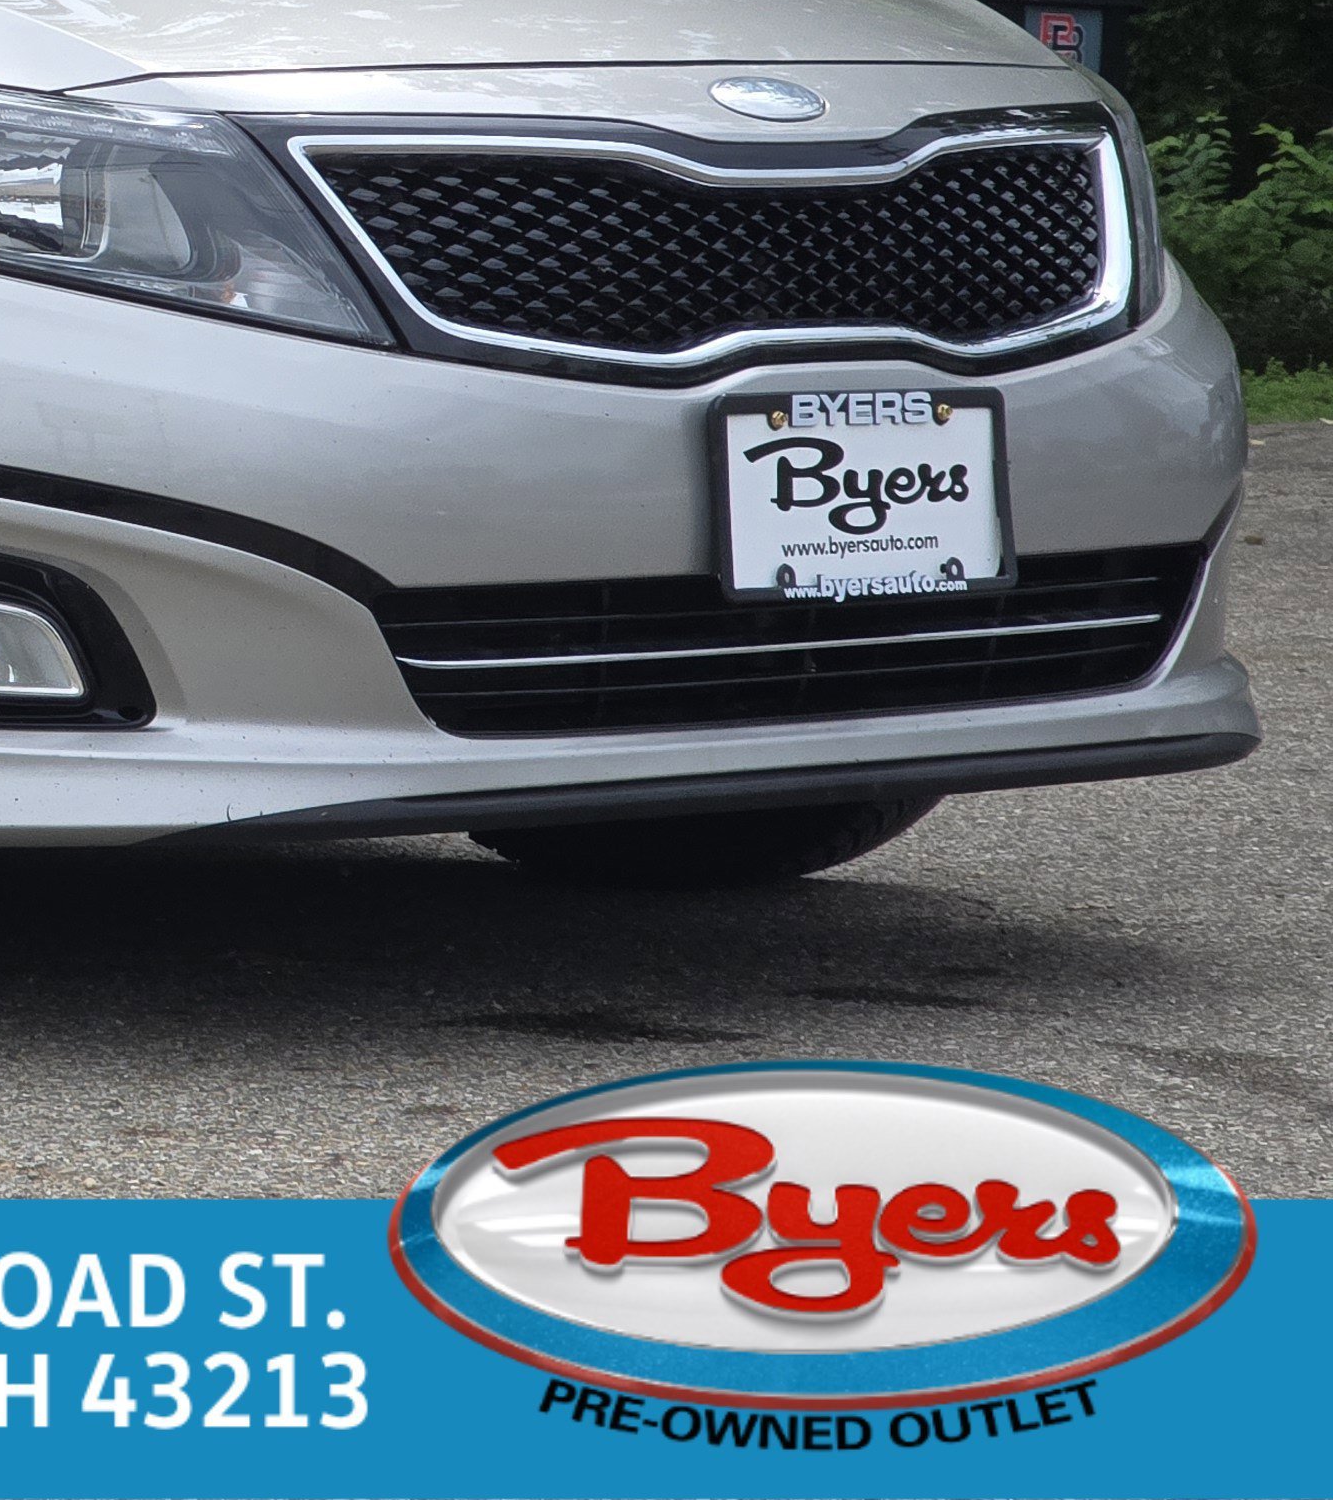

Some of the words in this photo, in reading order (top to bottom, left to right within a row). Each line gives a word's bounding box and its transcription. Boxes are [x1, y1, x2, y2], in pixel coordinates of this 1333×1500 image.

[791, 391, 933, 427] BYERS
[743, 436, 970, 535] Byers
[781, 534, 939, 559] www.byersauto.com
[783, 571, 968, 602] www.byersauto.com
